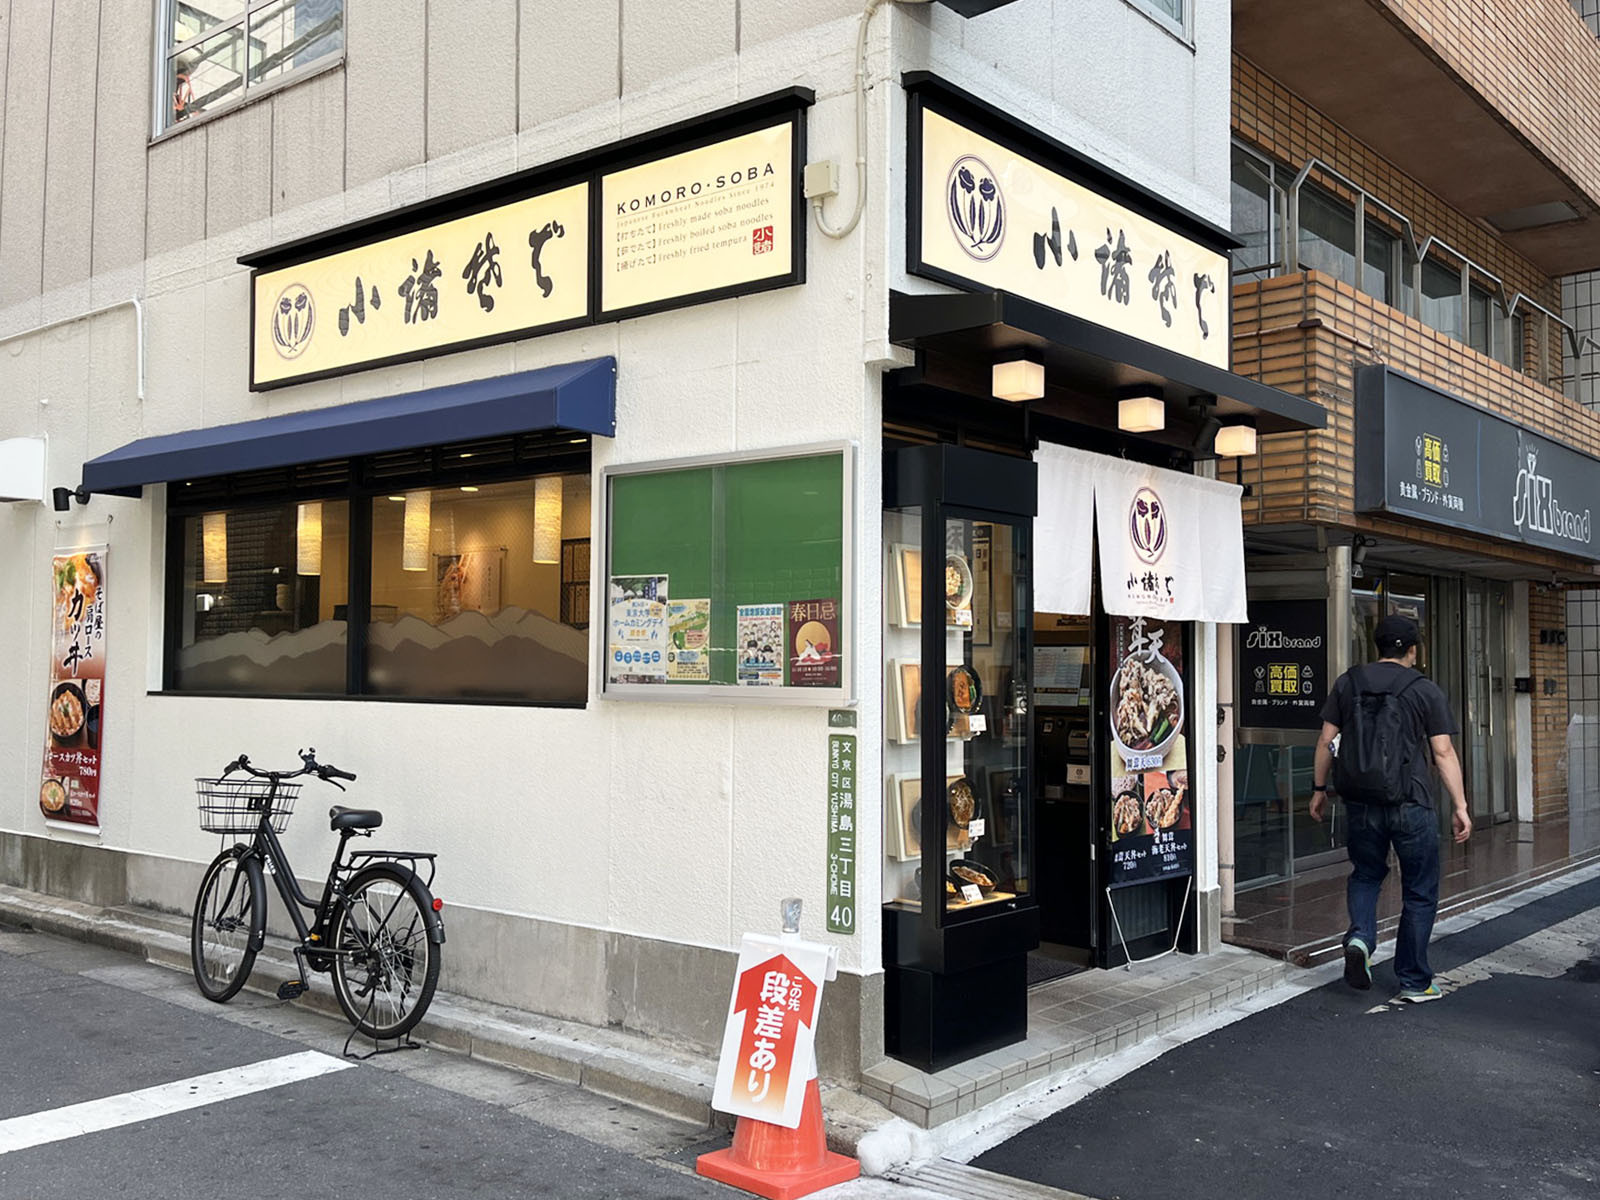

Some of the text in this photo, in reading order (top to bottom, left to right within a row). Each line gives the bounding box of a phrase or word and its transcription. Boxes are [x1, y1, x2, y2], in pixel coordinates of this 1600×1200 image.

[690, 211, 712, 223] made
[714, 204, 733, 216] soba
[736, 197, 769, 211] noodles
[690, 223, 716, 238] boiled
[718, 218, 737, 230] soba
[740, 213, 774, 227] noodles
[690, 241, 710, 255] fried
[712, 235, 748, 249] tempura
[1424, 438, 1441, 462] 高価
[1424, 460, 1441, 485] 買取
[1553, 499, 1591, 543] brand
[94, 587, 104, 640] そば屋の
[790, 602, 836, 622] 春日忌
[84, 605, 93, 658] 肩ロース
[1283, 636, 1321, 648] brand
[1269, 665, 1297, 679] 高価
[1270, 679, 1297, 693] 買取
[830, 740, 840, 896] BUNKYO CITY YUSHIMA 3-CHOME
[830, 905, 852, 927] 40
[787, 976, 803, 1012] この先
[748, 971, 791, 1103] 段差あり
